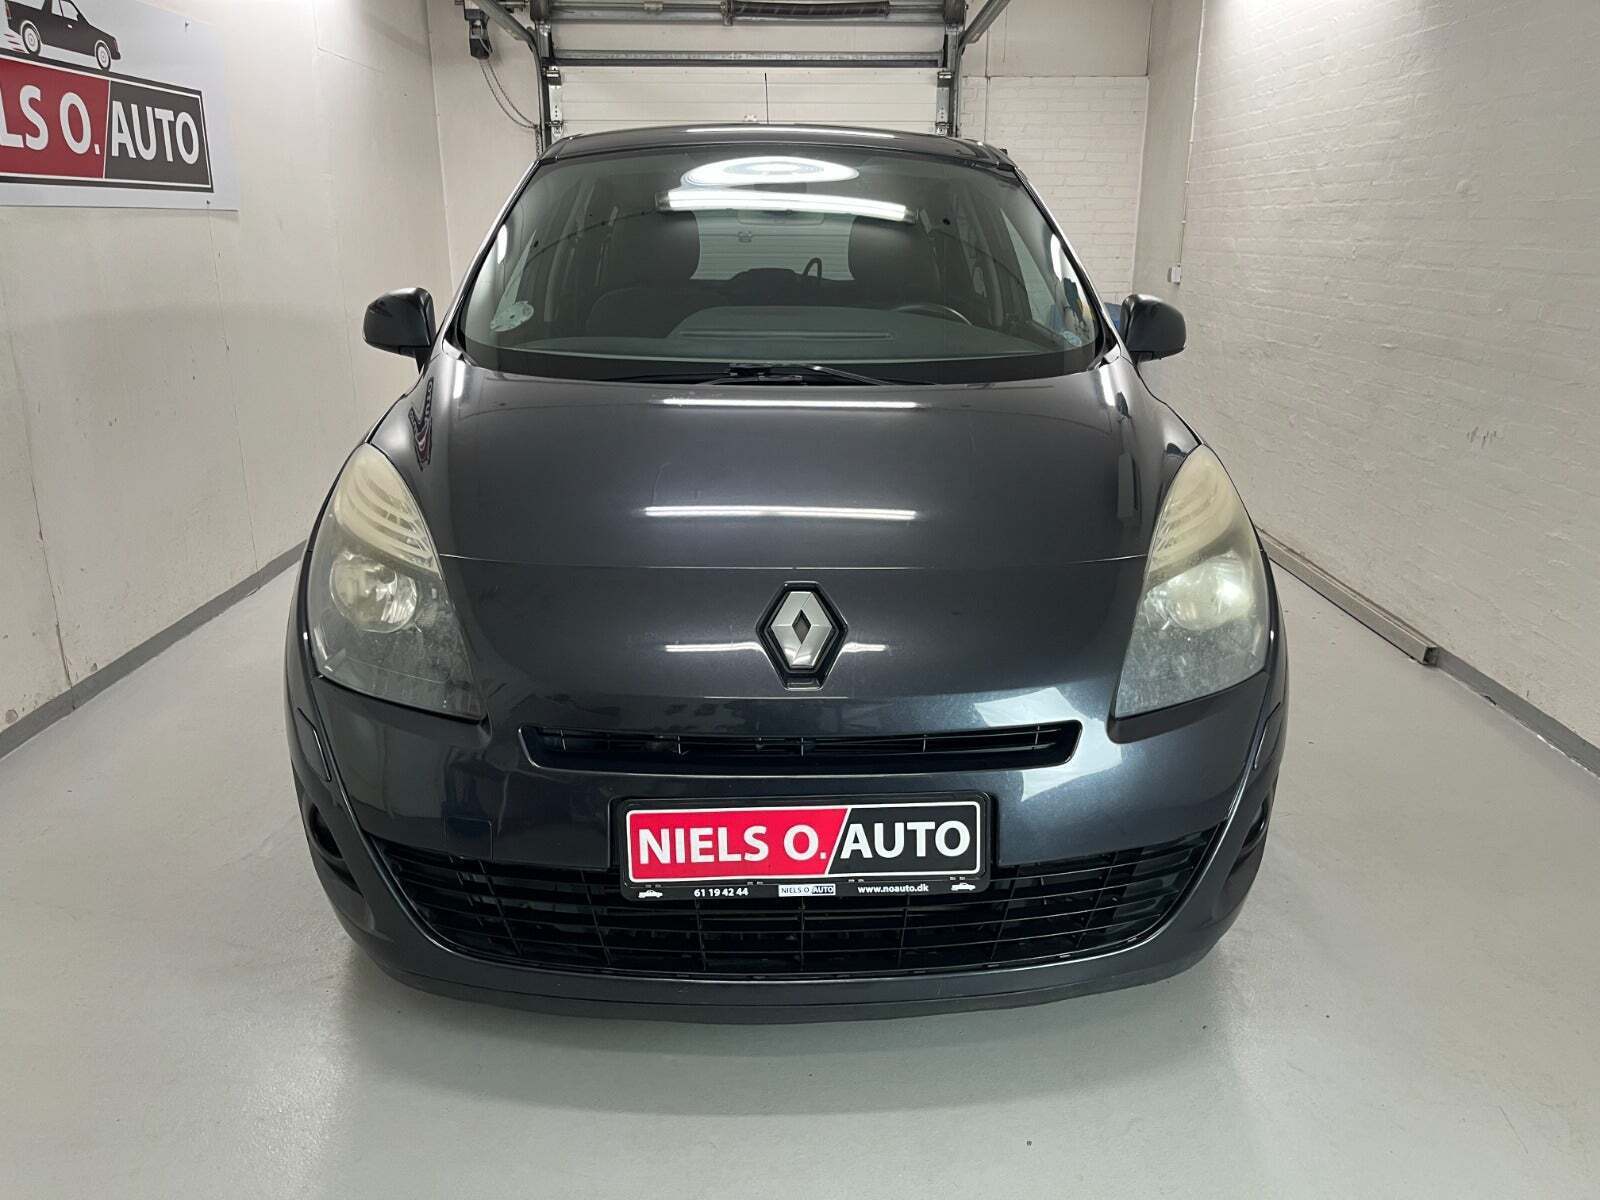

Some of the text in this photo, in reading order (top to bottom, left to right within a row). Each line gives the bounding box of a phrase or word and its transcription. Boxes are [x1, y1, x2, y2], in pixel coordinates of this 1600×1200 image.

[59, 92, 101, 155] O.
[111, 100, 200, 165] AUTO
[638, 820, 971, 865] NIELS O. AUTO
[693, 887, 749, 897] 61 19 42 44
[813, 886, 834, 894] AUTO
[857, 884, 929, 893] www.noauto.dk
